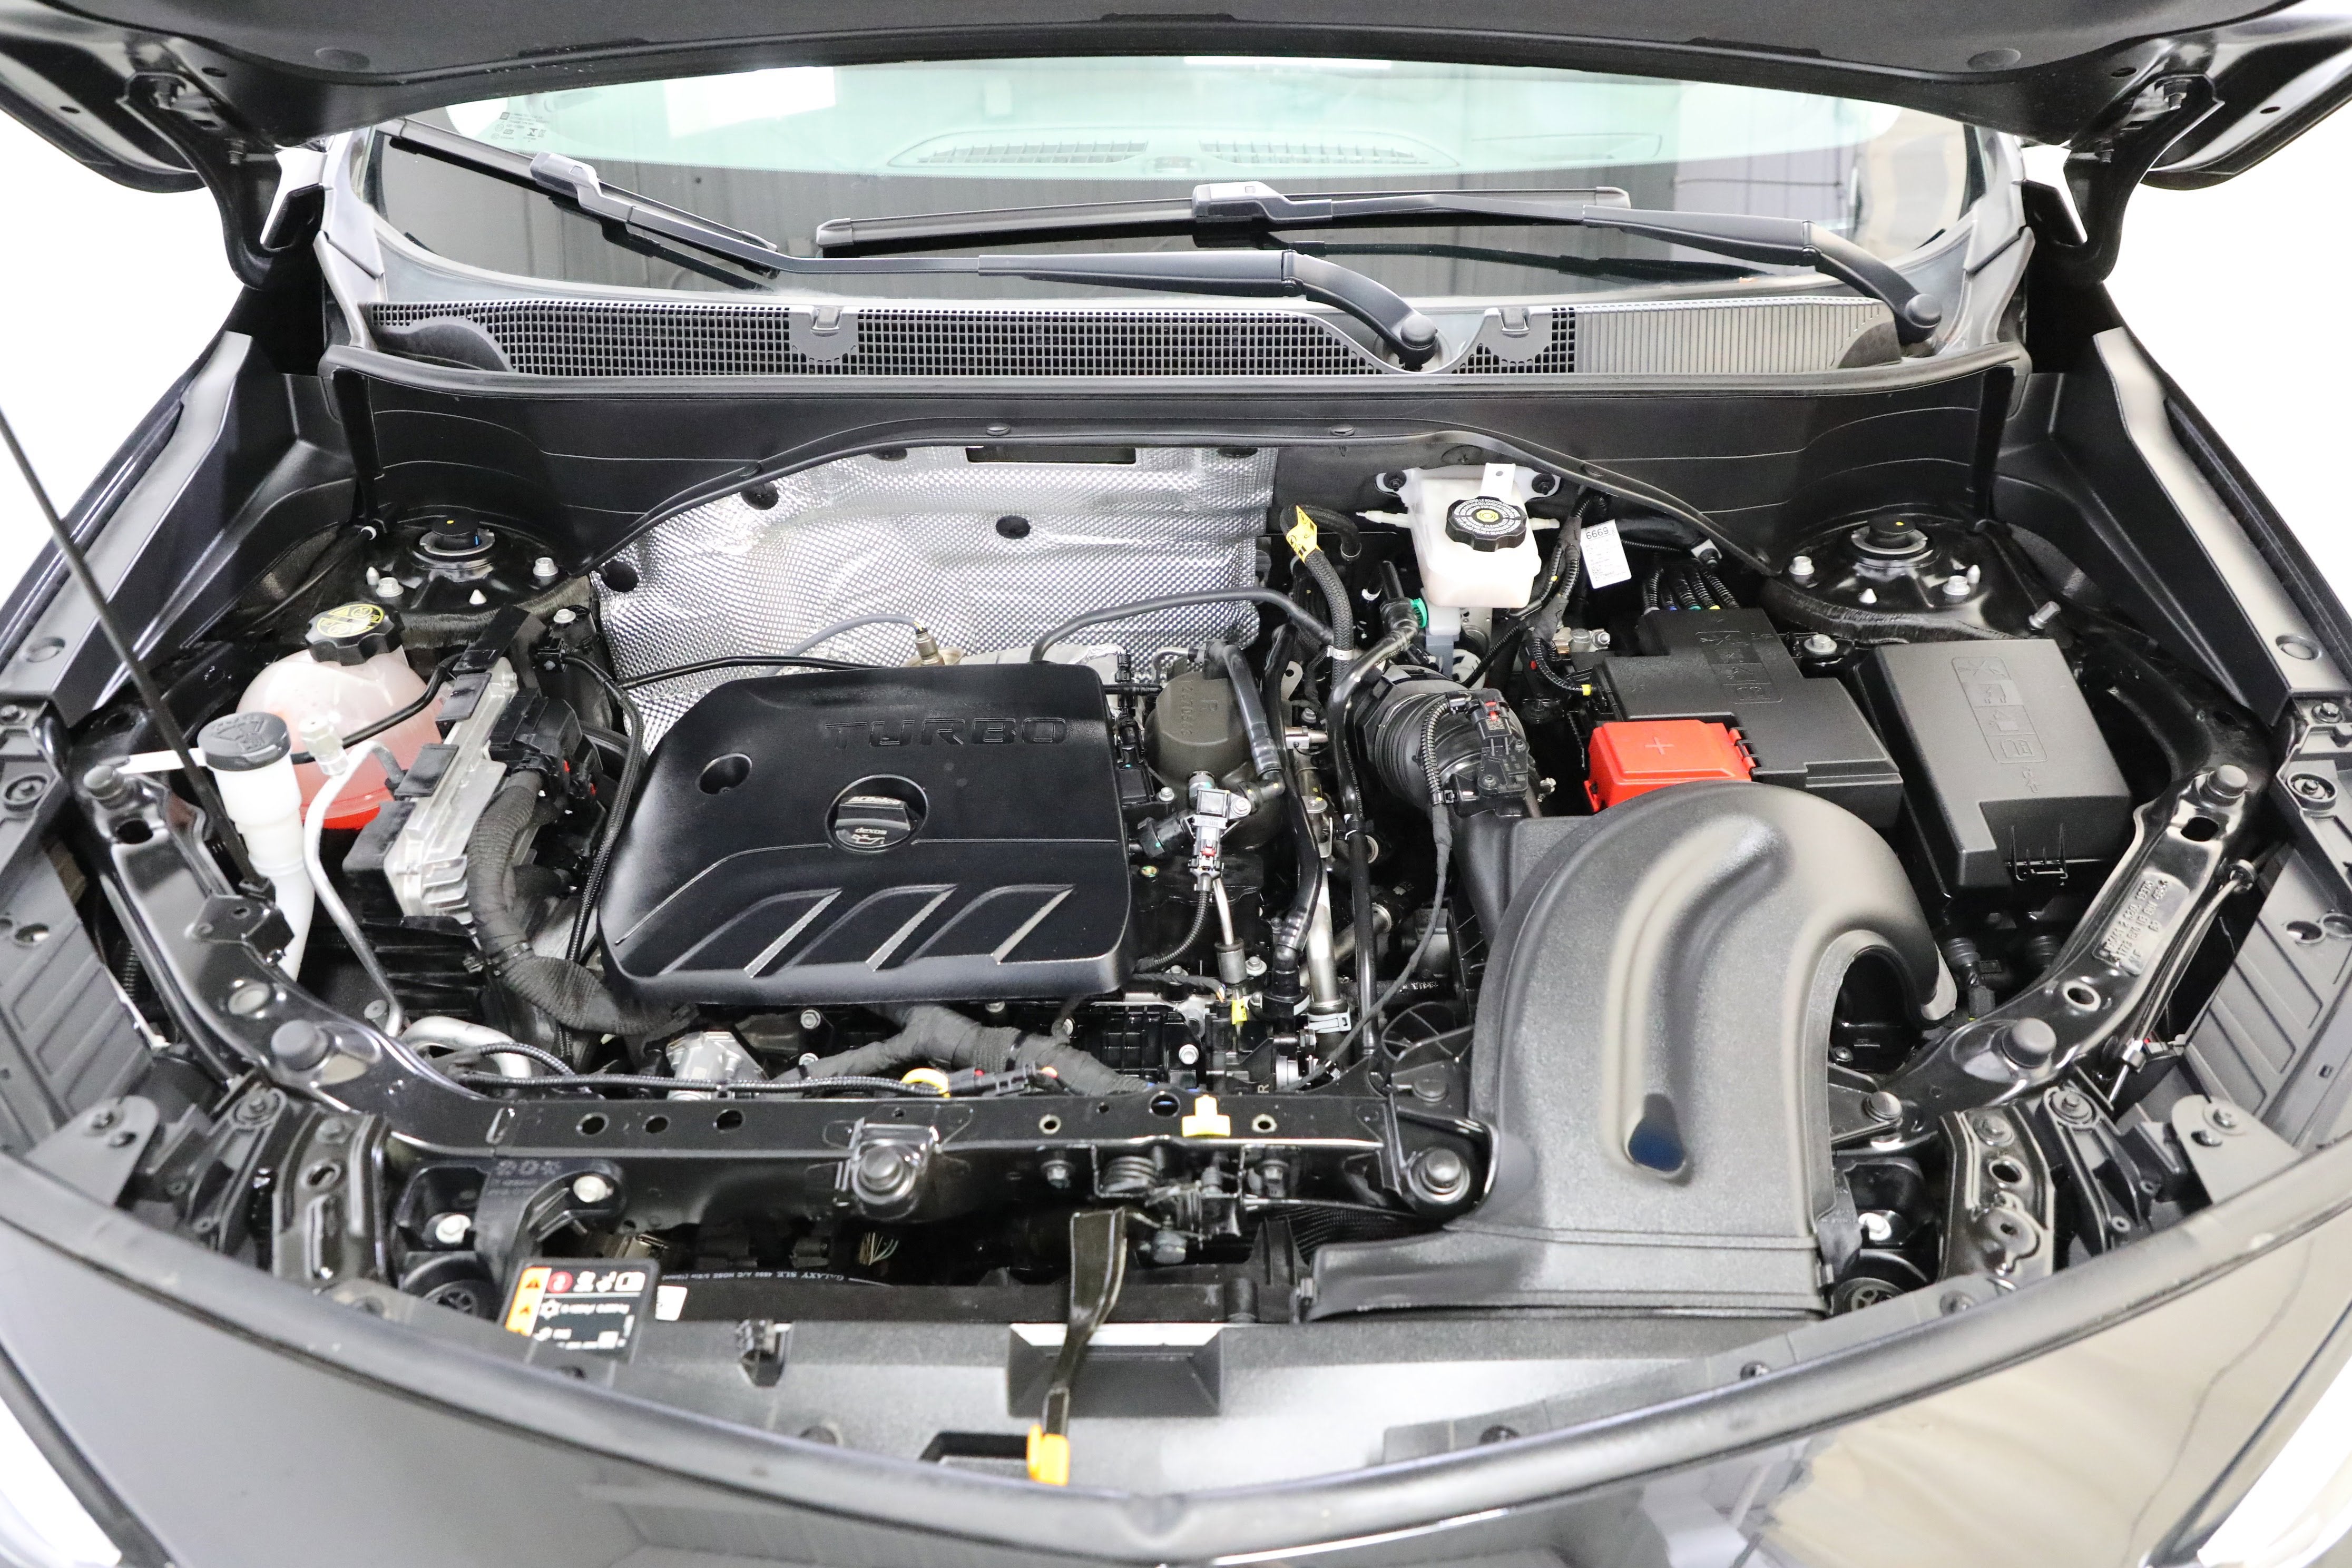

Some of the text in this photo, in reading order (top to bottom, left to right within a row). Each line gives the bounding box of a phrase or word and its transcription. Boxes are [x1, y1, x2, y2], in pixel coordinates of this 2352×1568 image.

[1586, 527, 1609, 540] 6669
[825, 717, 1067, 750] TURBO
[848, 796, 901, 805] ACDelco
[855, 827, 888, 835] dexos
[1258, 1084, 1269, 1093] R
[801, 1271, 845, 1282] GALAXY
